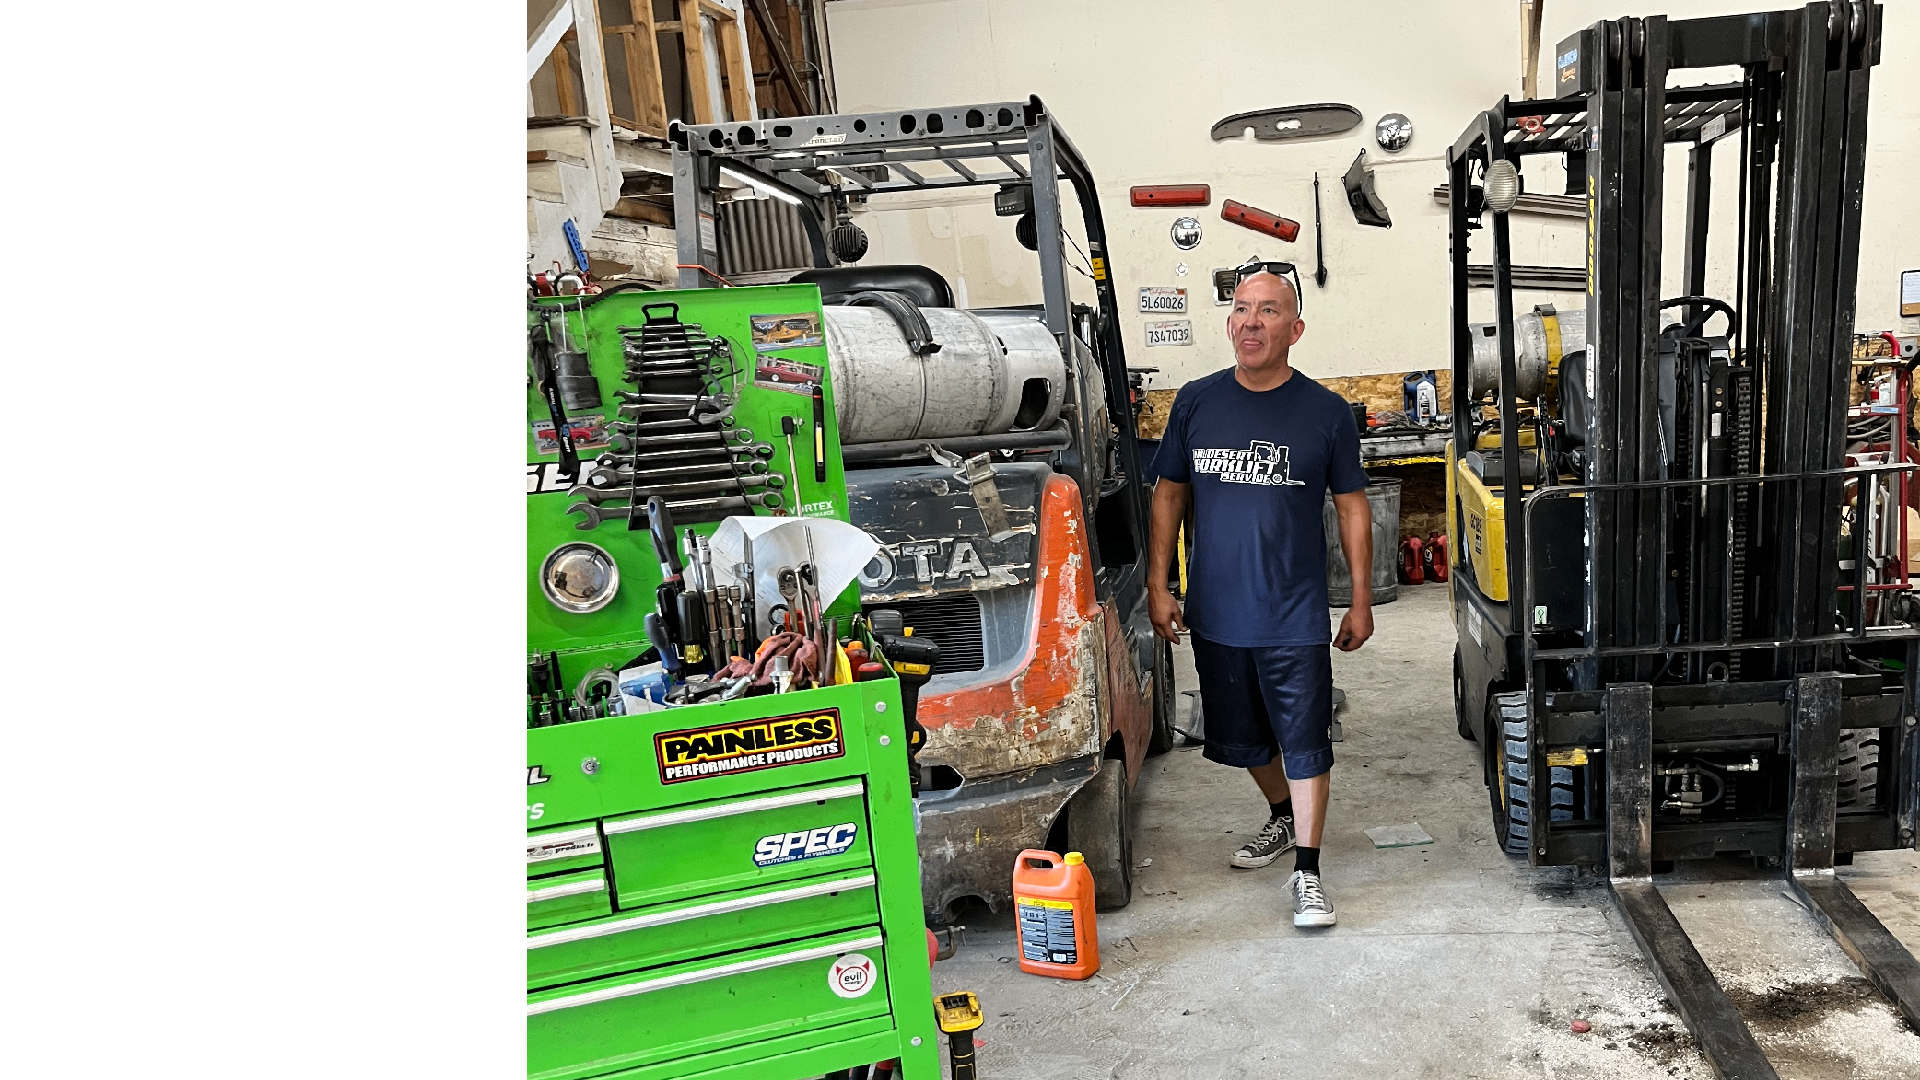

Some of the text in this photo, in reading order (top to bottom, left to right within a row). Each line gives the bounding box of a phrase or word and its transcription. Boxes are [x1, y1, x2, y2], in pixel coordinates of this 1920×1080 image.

[1141, 296, 1184, 310] 5L60026
[1148, 329, 1189, 343] 7S47039
[1206, 450, 1254, 461] DESERT
[1194, 459, 1278, 475] FORKLIFT
[1221, 472, 1271, 484] SERVICE
[664, 717, 834, 764] PAINLESS
[666, 742, 839, 780] PERFORMANCE PRODUCTS
[754, 822, 857, 862] SPEC
[844, 971, 862, 982] evil
